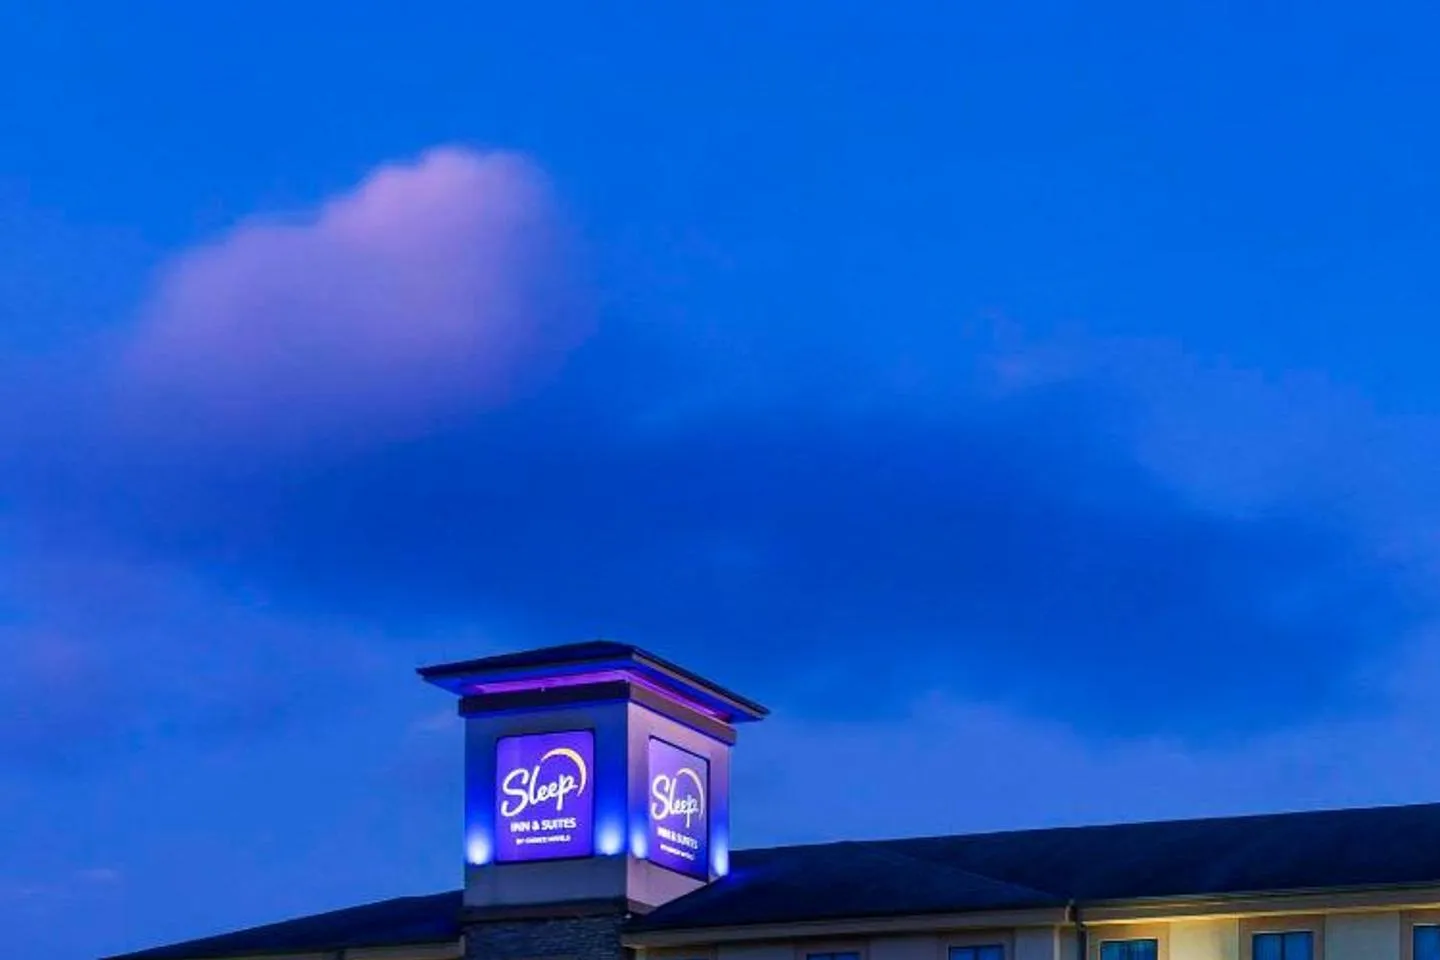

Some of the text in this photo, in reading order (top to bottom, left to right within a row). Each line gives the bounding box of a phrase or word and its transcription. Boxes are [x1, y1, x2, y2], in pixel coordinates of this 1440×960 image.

[501, 765, 578, 817] Sleep
[652, 774, 700, 829] Sleep
[510, 821, 530, 833] INN
[541, 817, 577, 831] SUITES
